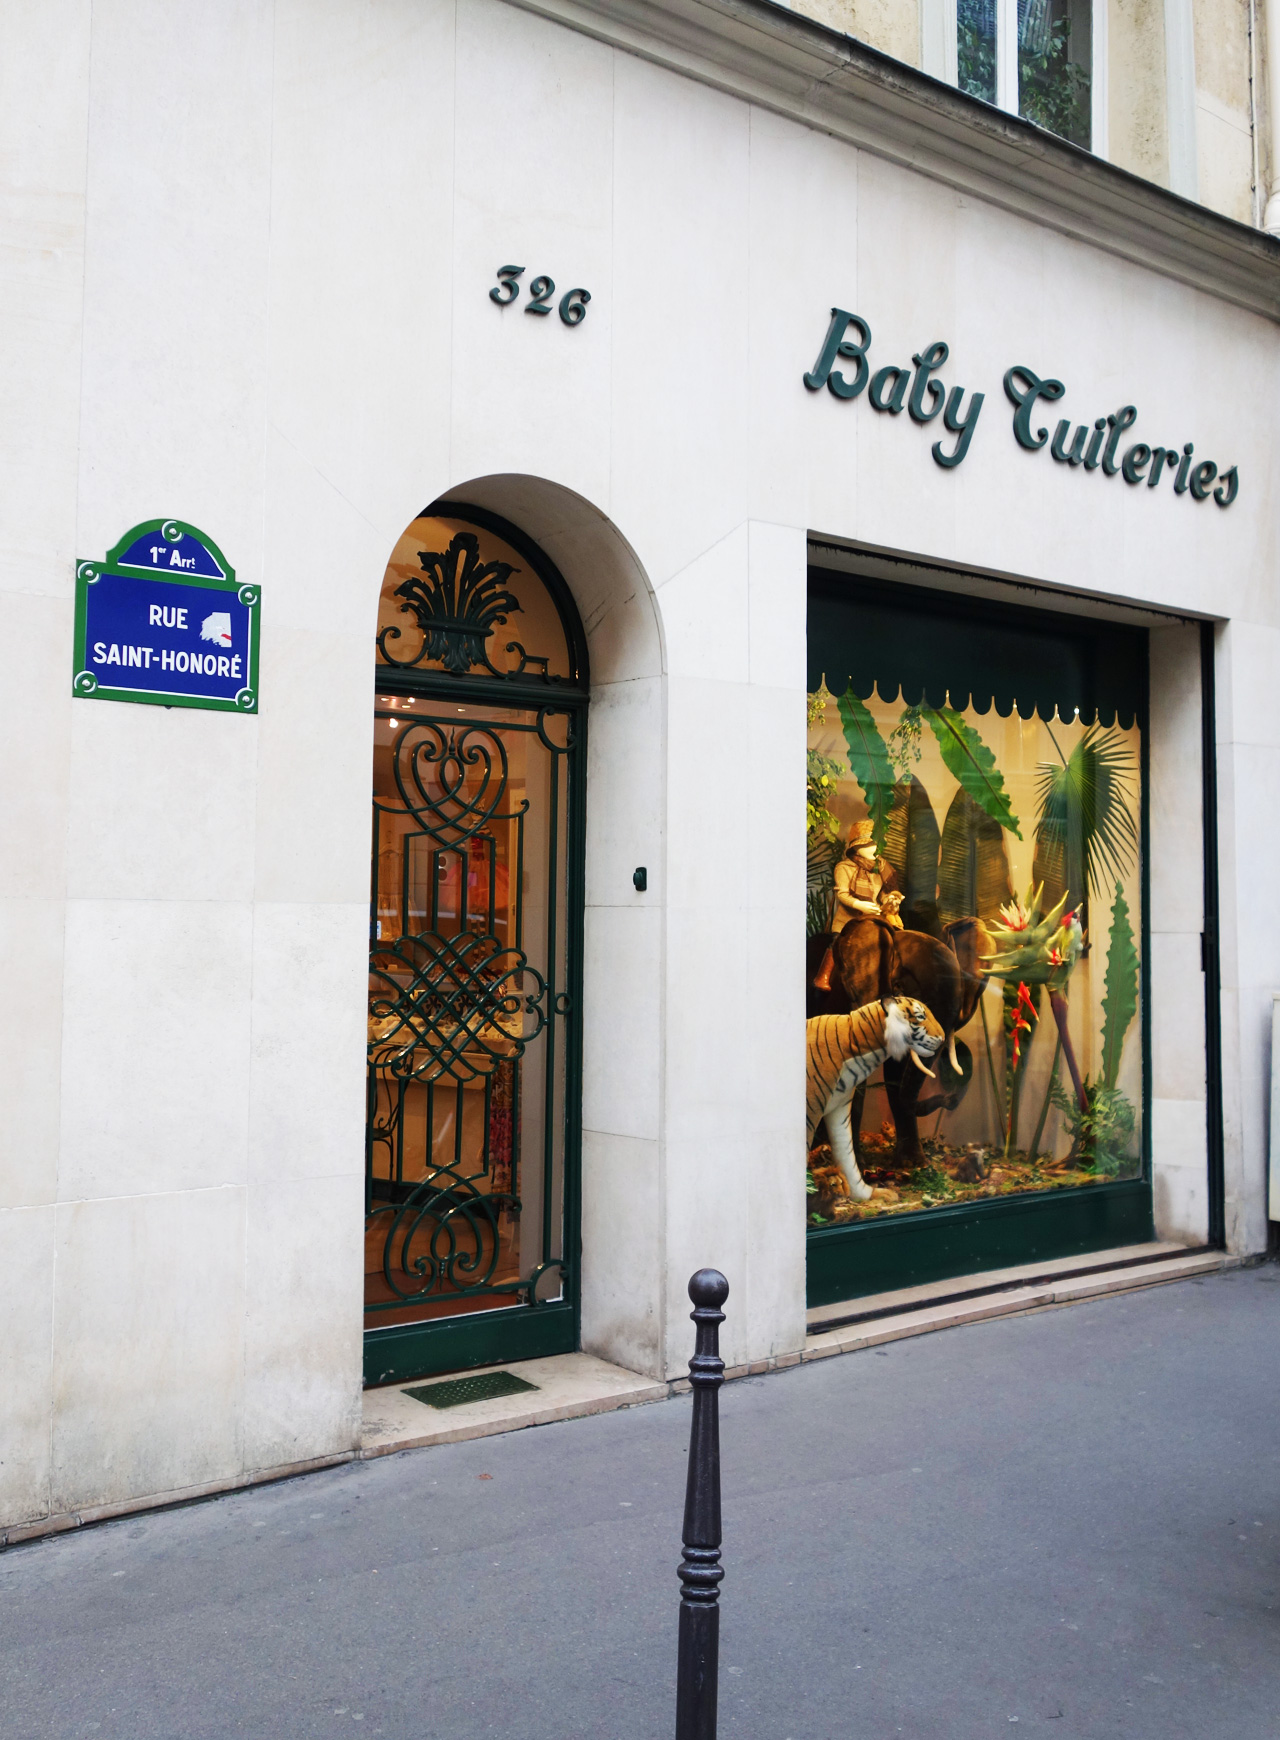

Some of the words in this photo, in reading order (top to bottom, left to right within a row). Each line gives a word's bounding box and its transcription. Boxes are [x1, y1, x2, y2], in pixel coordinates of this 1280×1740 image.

[489, 264, 591, 327] 326
[803, 307, 986, 469] Baby
[1003, 365, 1239, 507] Tuileries
[149, 546, 167, 563] 1er
[149, 604, 188, 629] RUE
[93, 642, 242, 679] SAINT-HONORÉ
